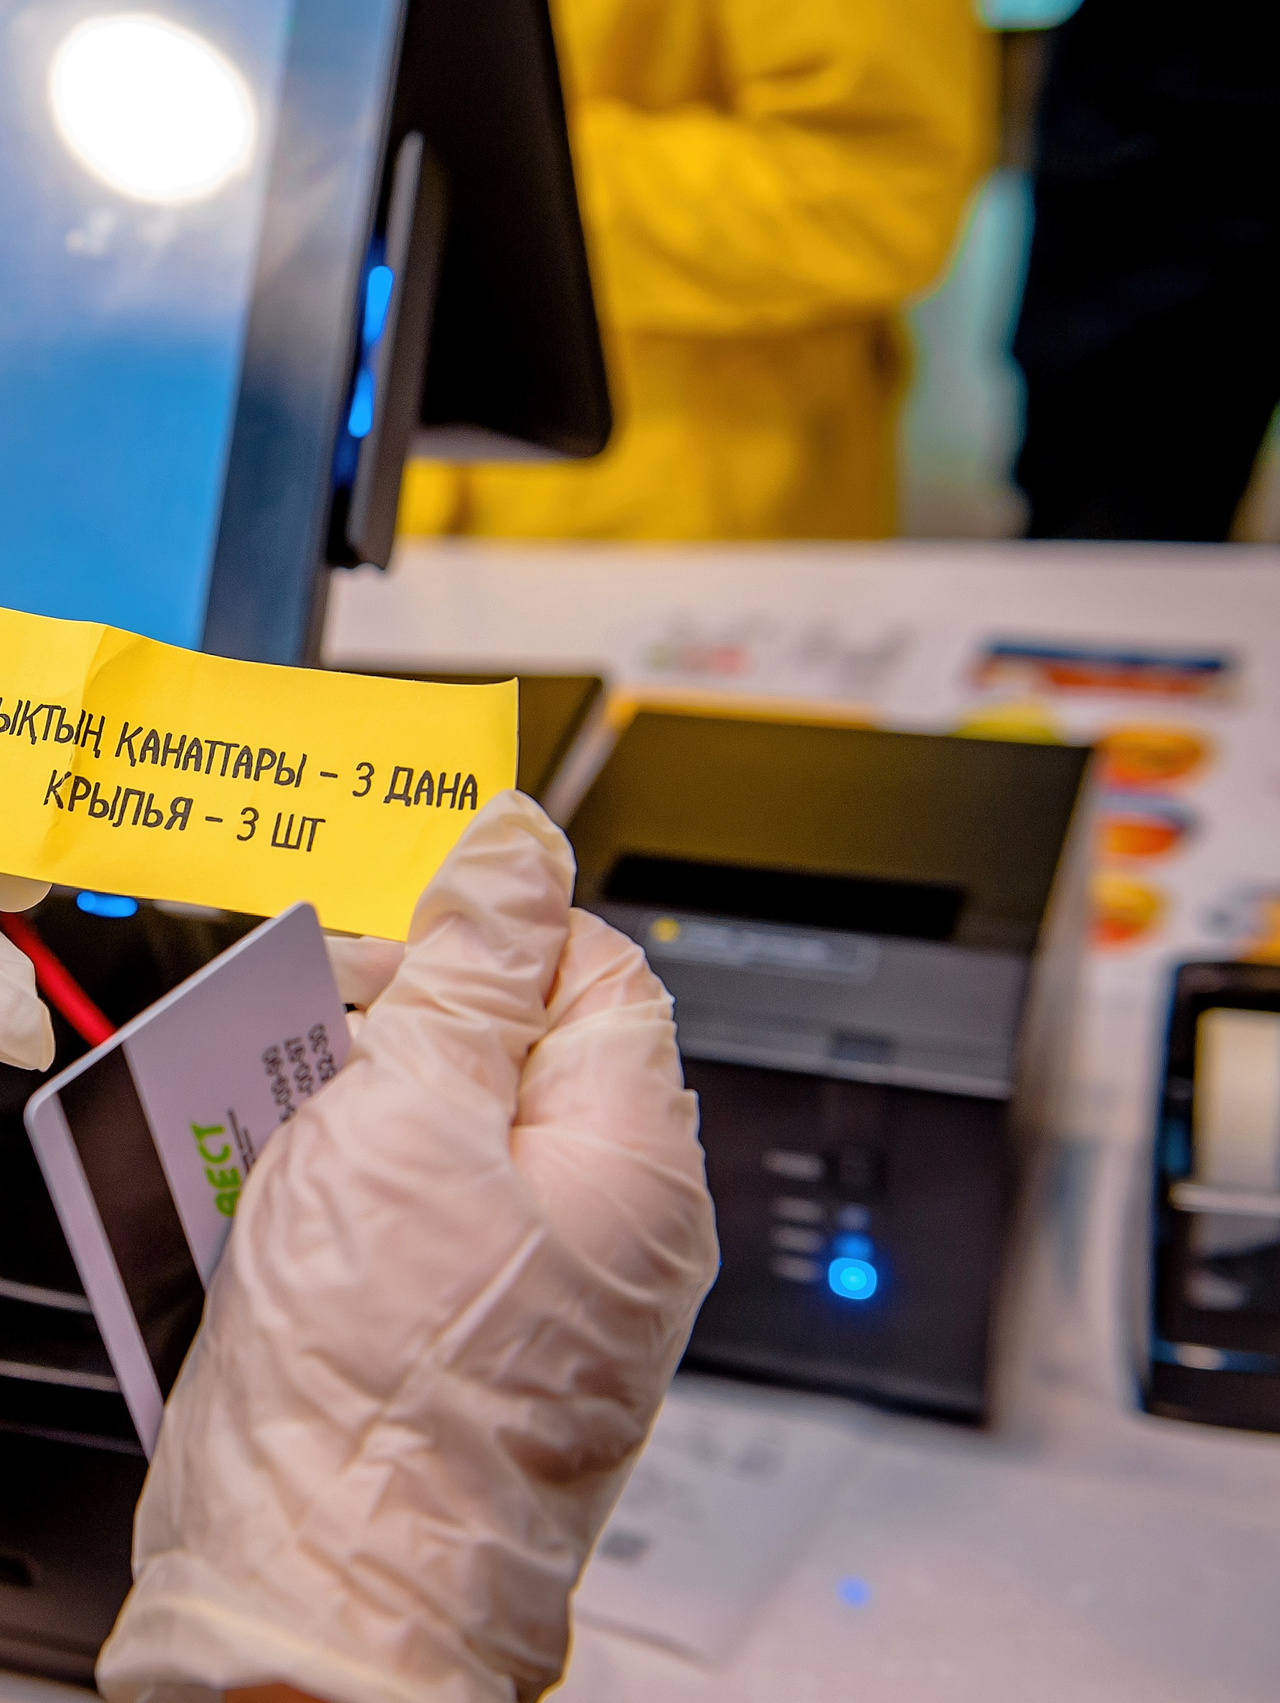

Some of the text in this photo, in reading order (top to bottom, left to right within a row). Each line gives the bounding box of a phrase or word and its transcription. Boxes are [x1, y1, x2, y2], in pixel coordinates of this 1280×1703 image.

[114, 721, 308, 788] ҚАНАТТАРЫ
[352, 762, 375, 798] 3
[382, 765, 478, 811] ДАНА
[43, 769, 194, 831] КРЫЛЬЯ
[236, 806, 260, 842] 3
[270, 812, 326, 853] ШТ
